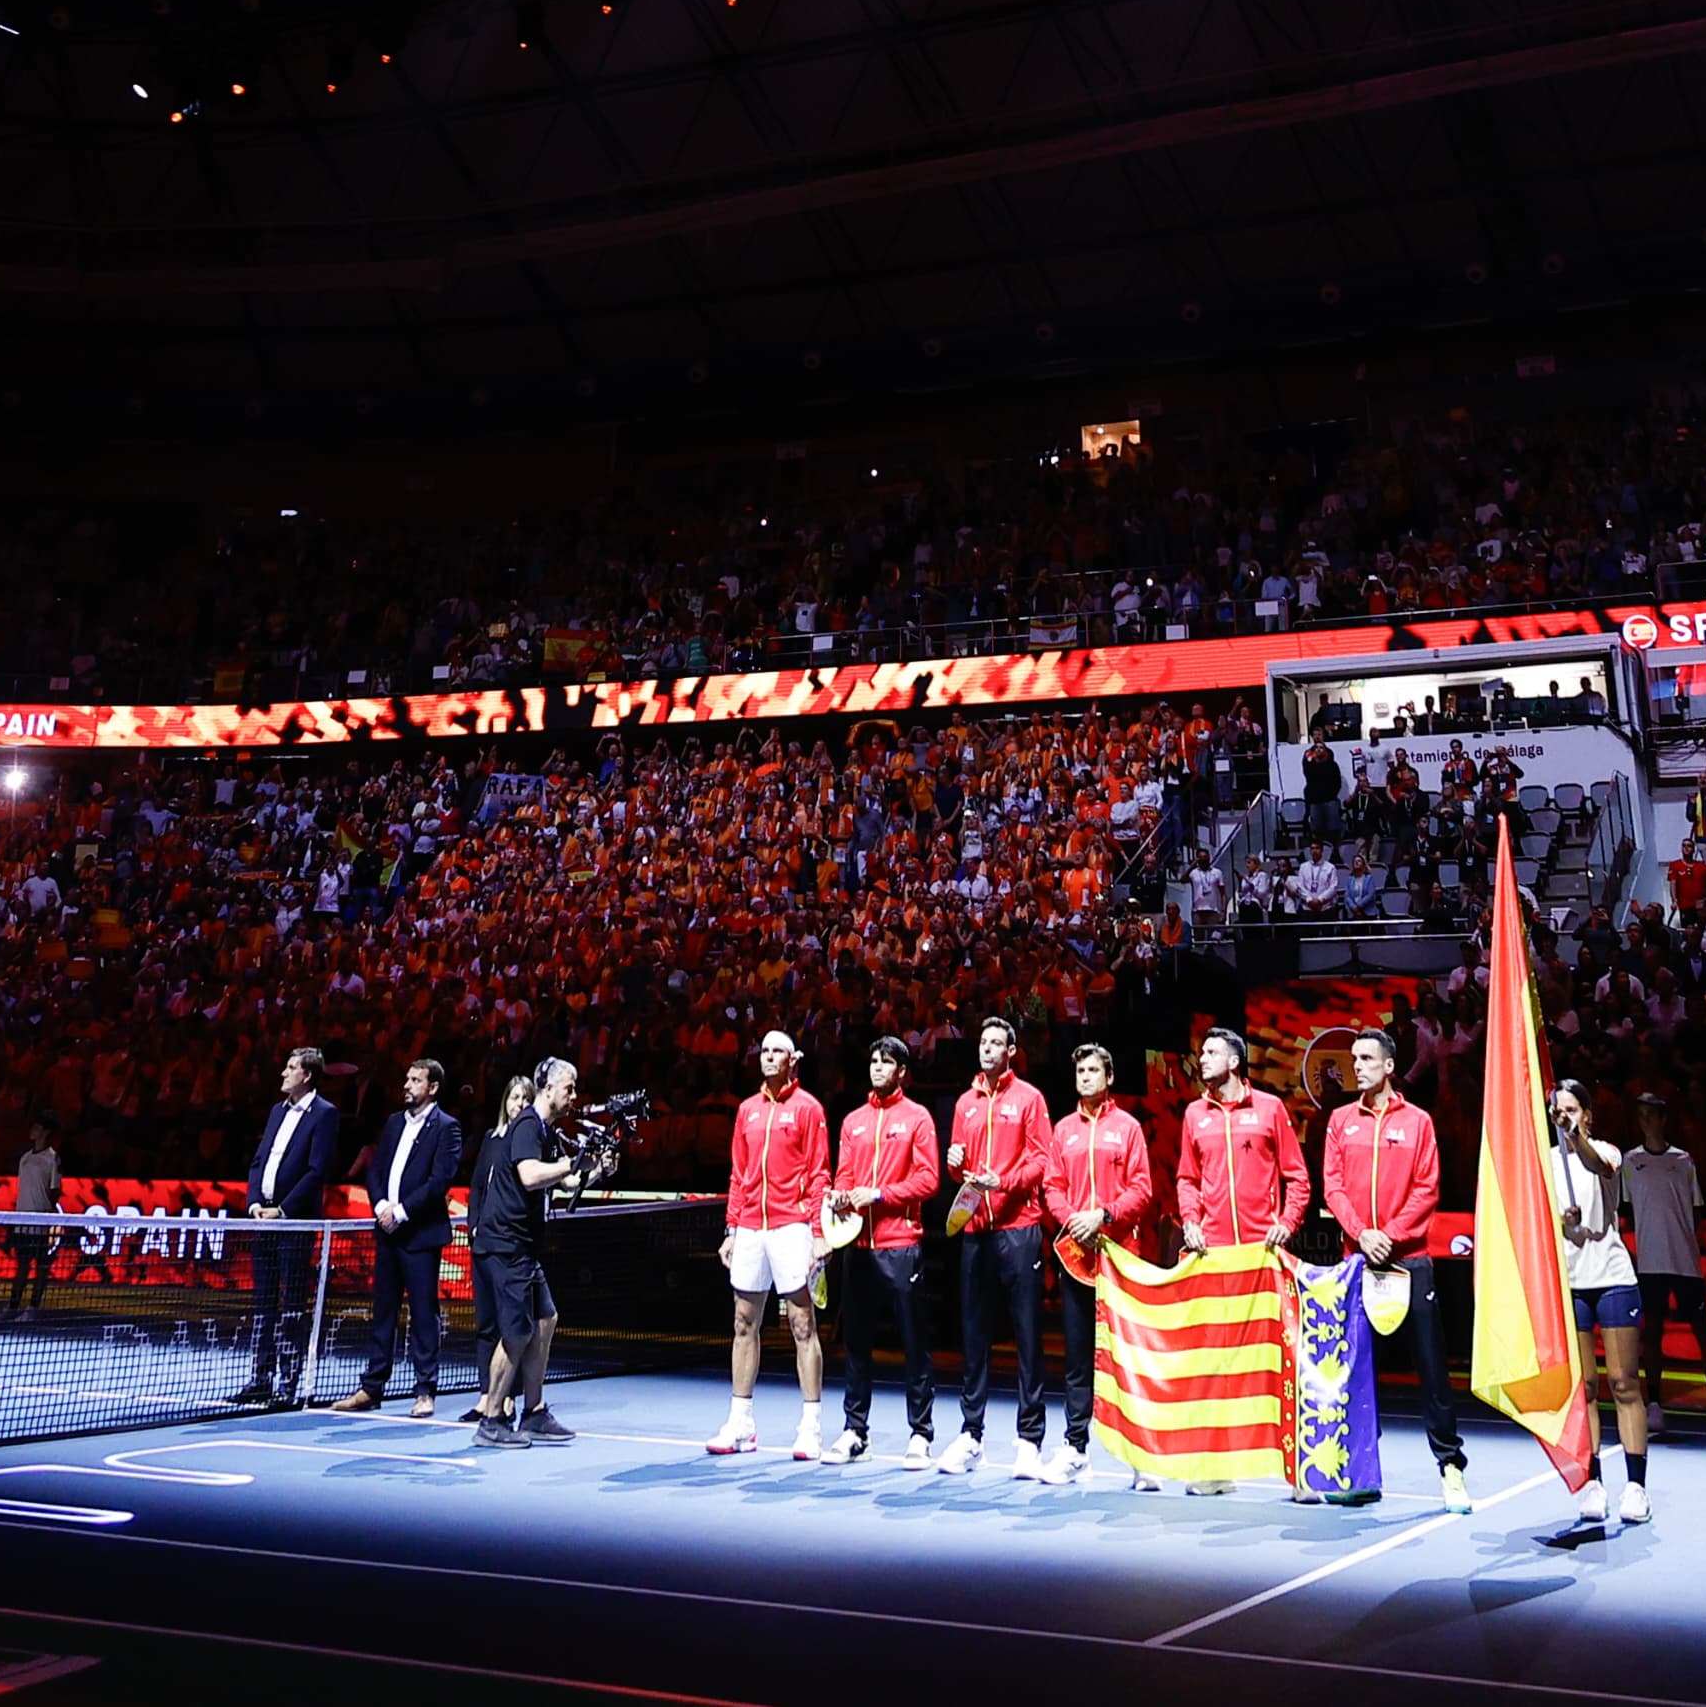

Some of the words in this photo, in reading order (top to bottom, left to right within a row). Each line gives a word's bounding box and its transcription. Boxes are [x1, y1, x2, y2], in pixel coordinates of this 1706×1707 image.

[1507, 745, 1543, 759] álaga
[488, 776, 543, 795] RAFA
[80, 1205, 227, 1260] SPAIN
